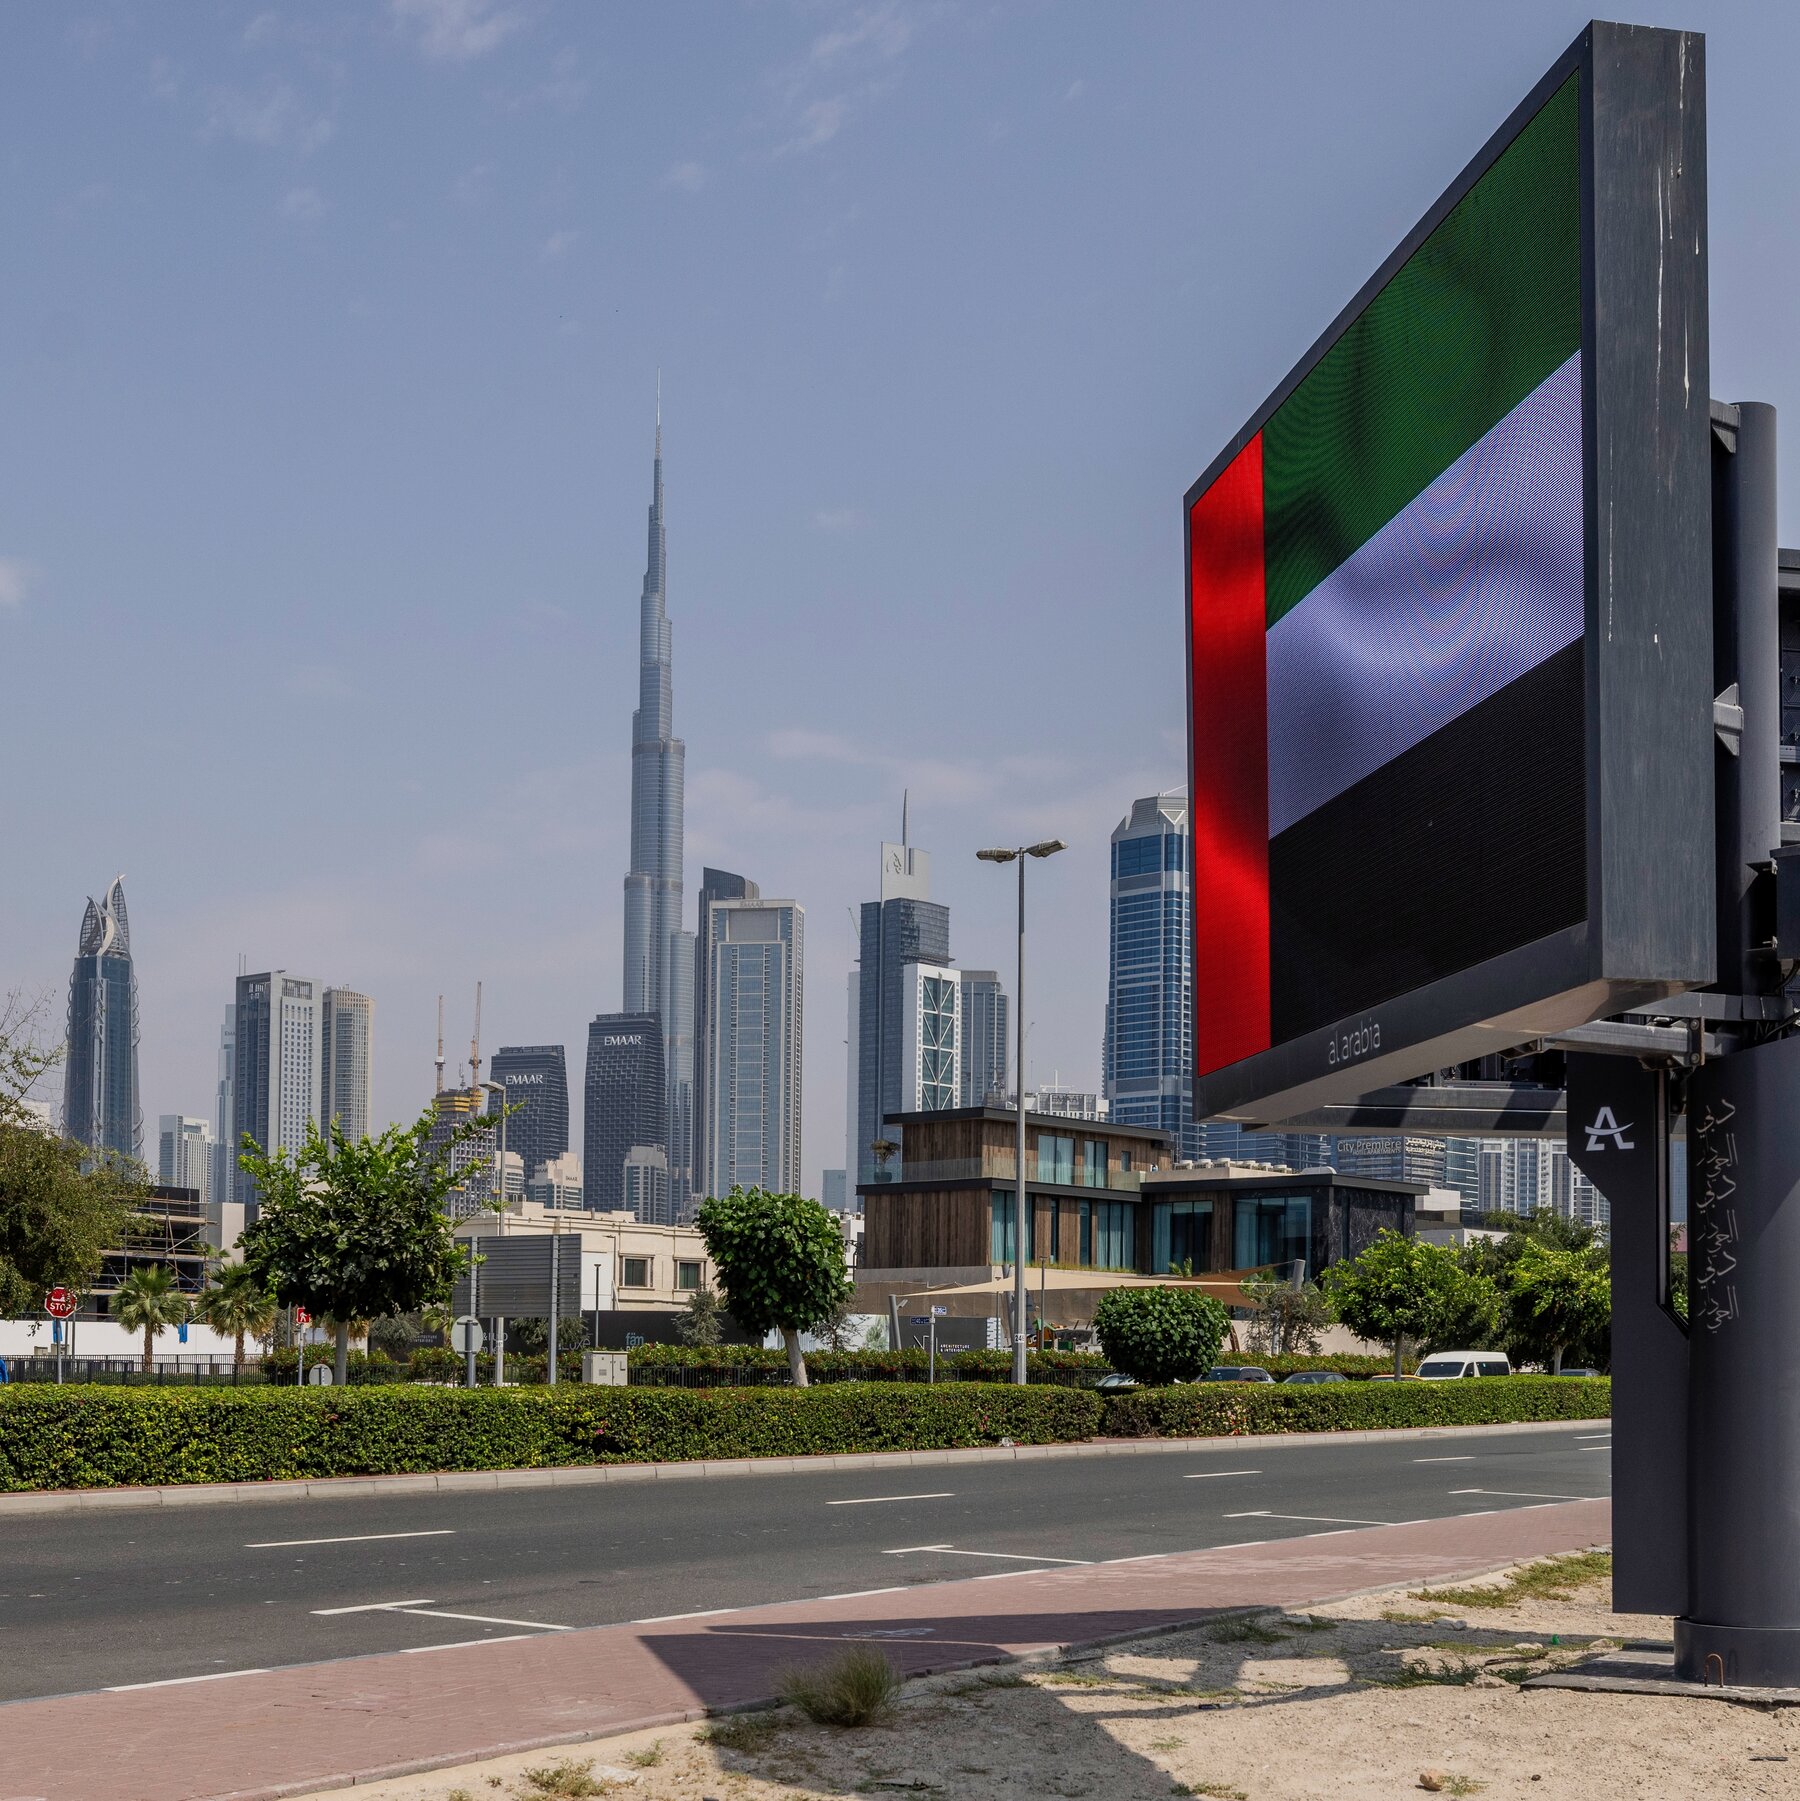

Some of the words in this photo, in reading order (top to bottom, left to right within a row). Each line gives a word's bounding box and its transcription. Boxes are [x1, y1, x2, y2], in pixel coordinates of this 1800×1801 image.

[604, 1035, 642, 1046] EMAAR
[505, 1074, 543, 1085] EMAAR
[1337, 1141, 1355, 1153] City
[50, 1303, 72, 1311] STOP
